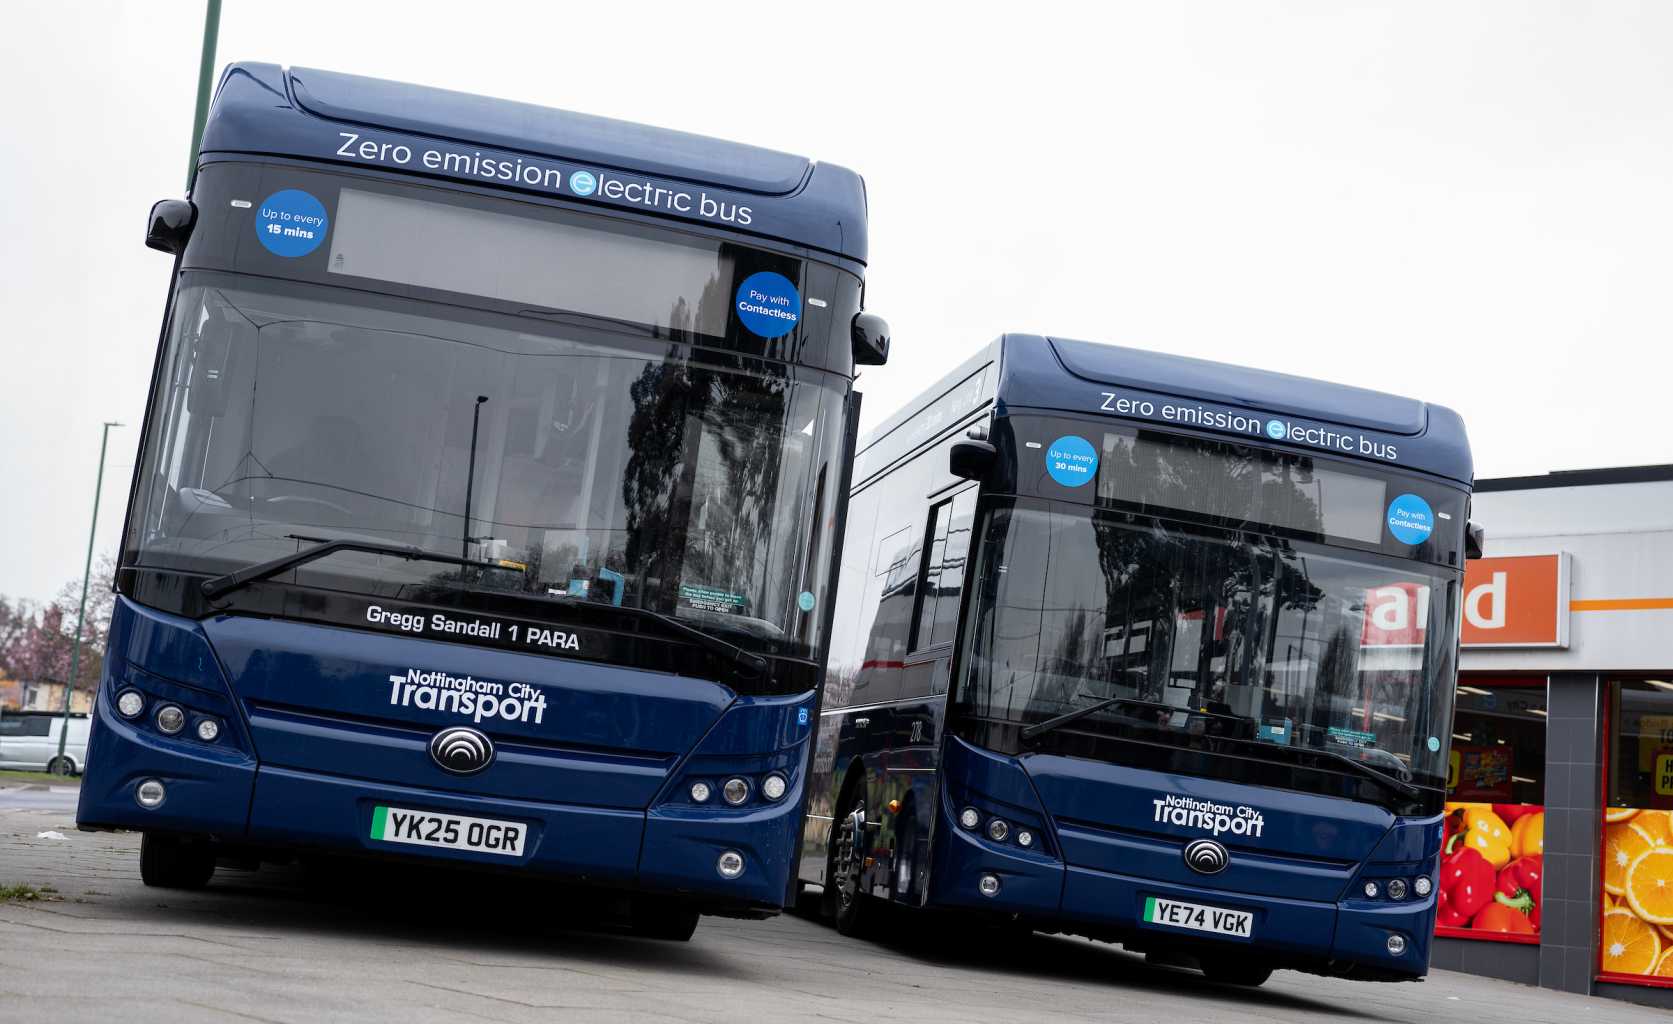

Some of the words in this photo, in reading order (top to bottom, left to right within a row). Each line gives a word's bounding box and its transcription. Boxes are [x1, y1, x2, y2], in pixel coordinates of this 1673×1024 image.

[336, 132, 412, 164] Zero
[422, 150, 561, 189] emission
[569, 170, 692, 212] electric
[699, 192, 753, 225] bus
[262, 208, 278, 220] Up
[280, 211, 291, 221] to
[293, 214, 324, 227] every
[267, 224, 282, 234] 15
[283, 227, 314, 239] mins
[739, 301, 797, 321] Contactless
[750, 289, 768, 303] Pay
[769, 296, 790, 306] with
[1100, 392, 1154, 416] Zero
[1161, 405, 1261, 434] emission
[1266, 420, 1354, 451] electric
[1359, 435, 1397, 460] bus
[1050, 449, 1062, 459] Up
[1063, 452, 1072, 460] to
[1072, 454, 1094, 464] every
[1055, 462, 1067, 470] 30
[1067, 464, 1087, 473] mins
[1389, 517, 1432, 532] Contactless
[1397, 507, 1410, 518] Pay
[1410, 511, 1426, 520] with
[366, 605, 425, 632] Gregg
[431, 614, 501, 639] Sandall
[508, 625, 519, 642] 1
[526, 627, 580, 650] PARA
[407, 668, 503, 696] Nottingham
[508, 682, 541, 700] City
[389, 675, 547, 725] Transport
[1153, 799, 1265, 837] Transport
[1165, 794, 1233, 816] Nottingham
[1236, 806, 1260, 821] City
[392, 812, 461, 844] YK25
[467, 822, 520, 852] OGR
[1158, 902, 1205, 927] YE74
[1212, 910, 1248, 934] VGK
